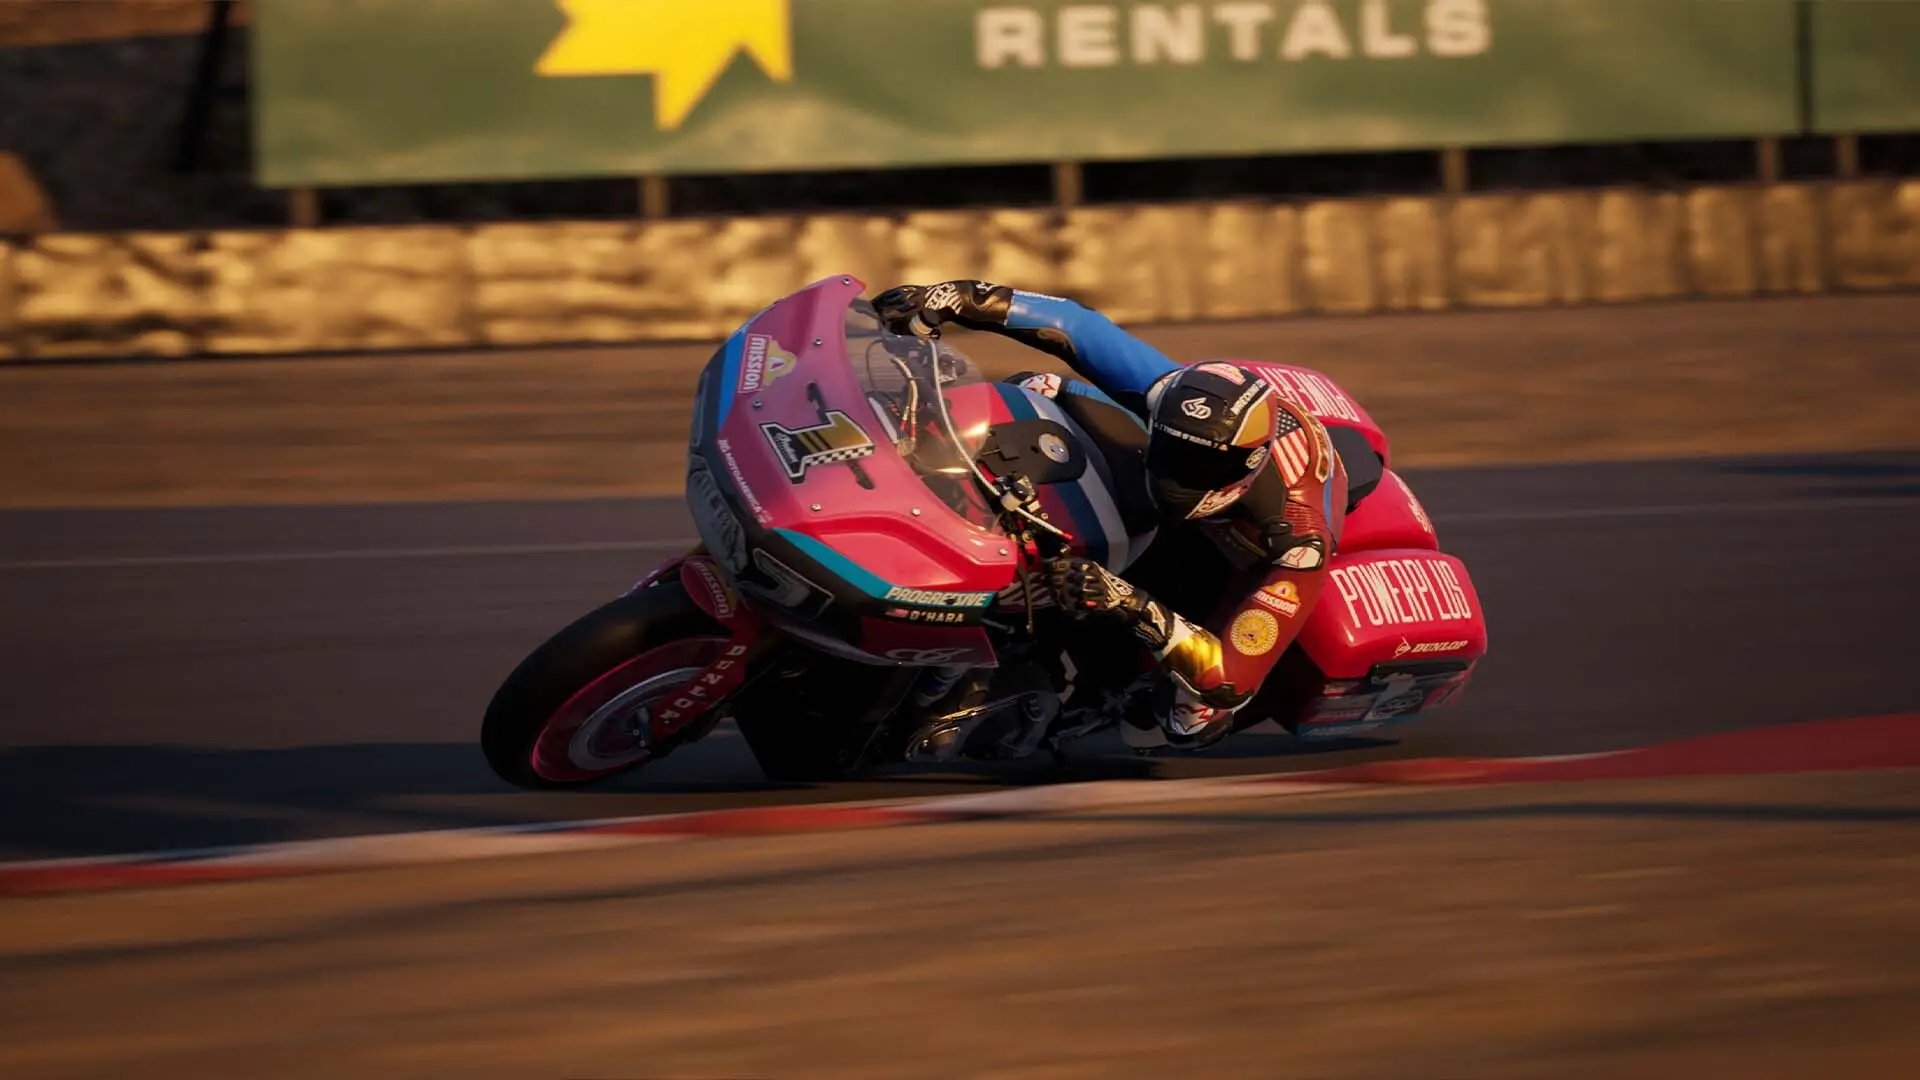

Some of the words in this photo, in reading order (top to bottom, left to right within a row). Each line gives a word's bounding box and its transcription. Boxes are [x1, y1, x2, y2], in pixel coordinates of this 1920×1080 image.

[976, 0, 1492, 69] RENTALS
[1329, 559, 1472, 628] POWERPLUS
[1411, 640, 1468, 653] DUNLOP
